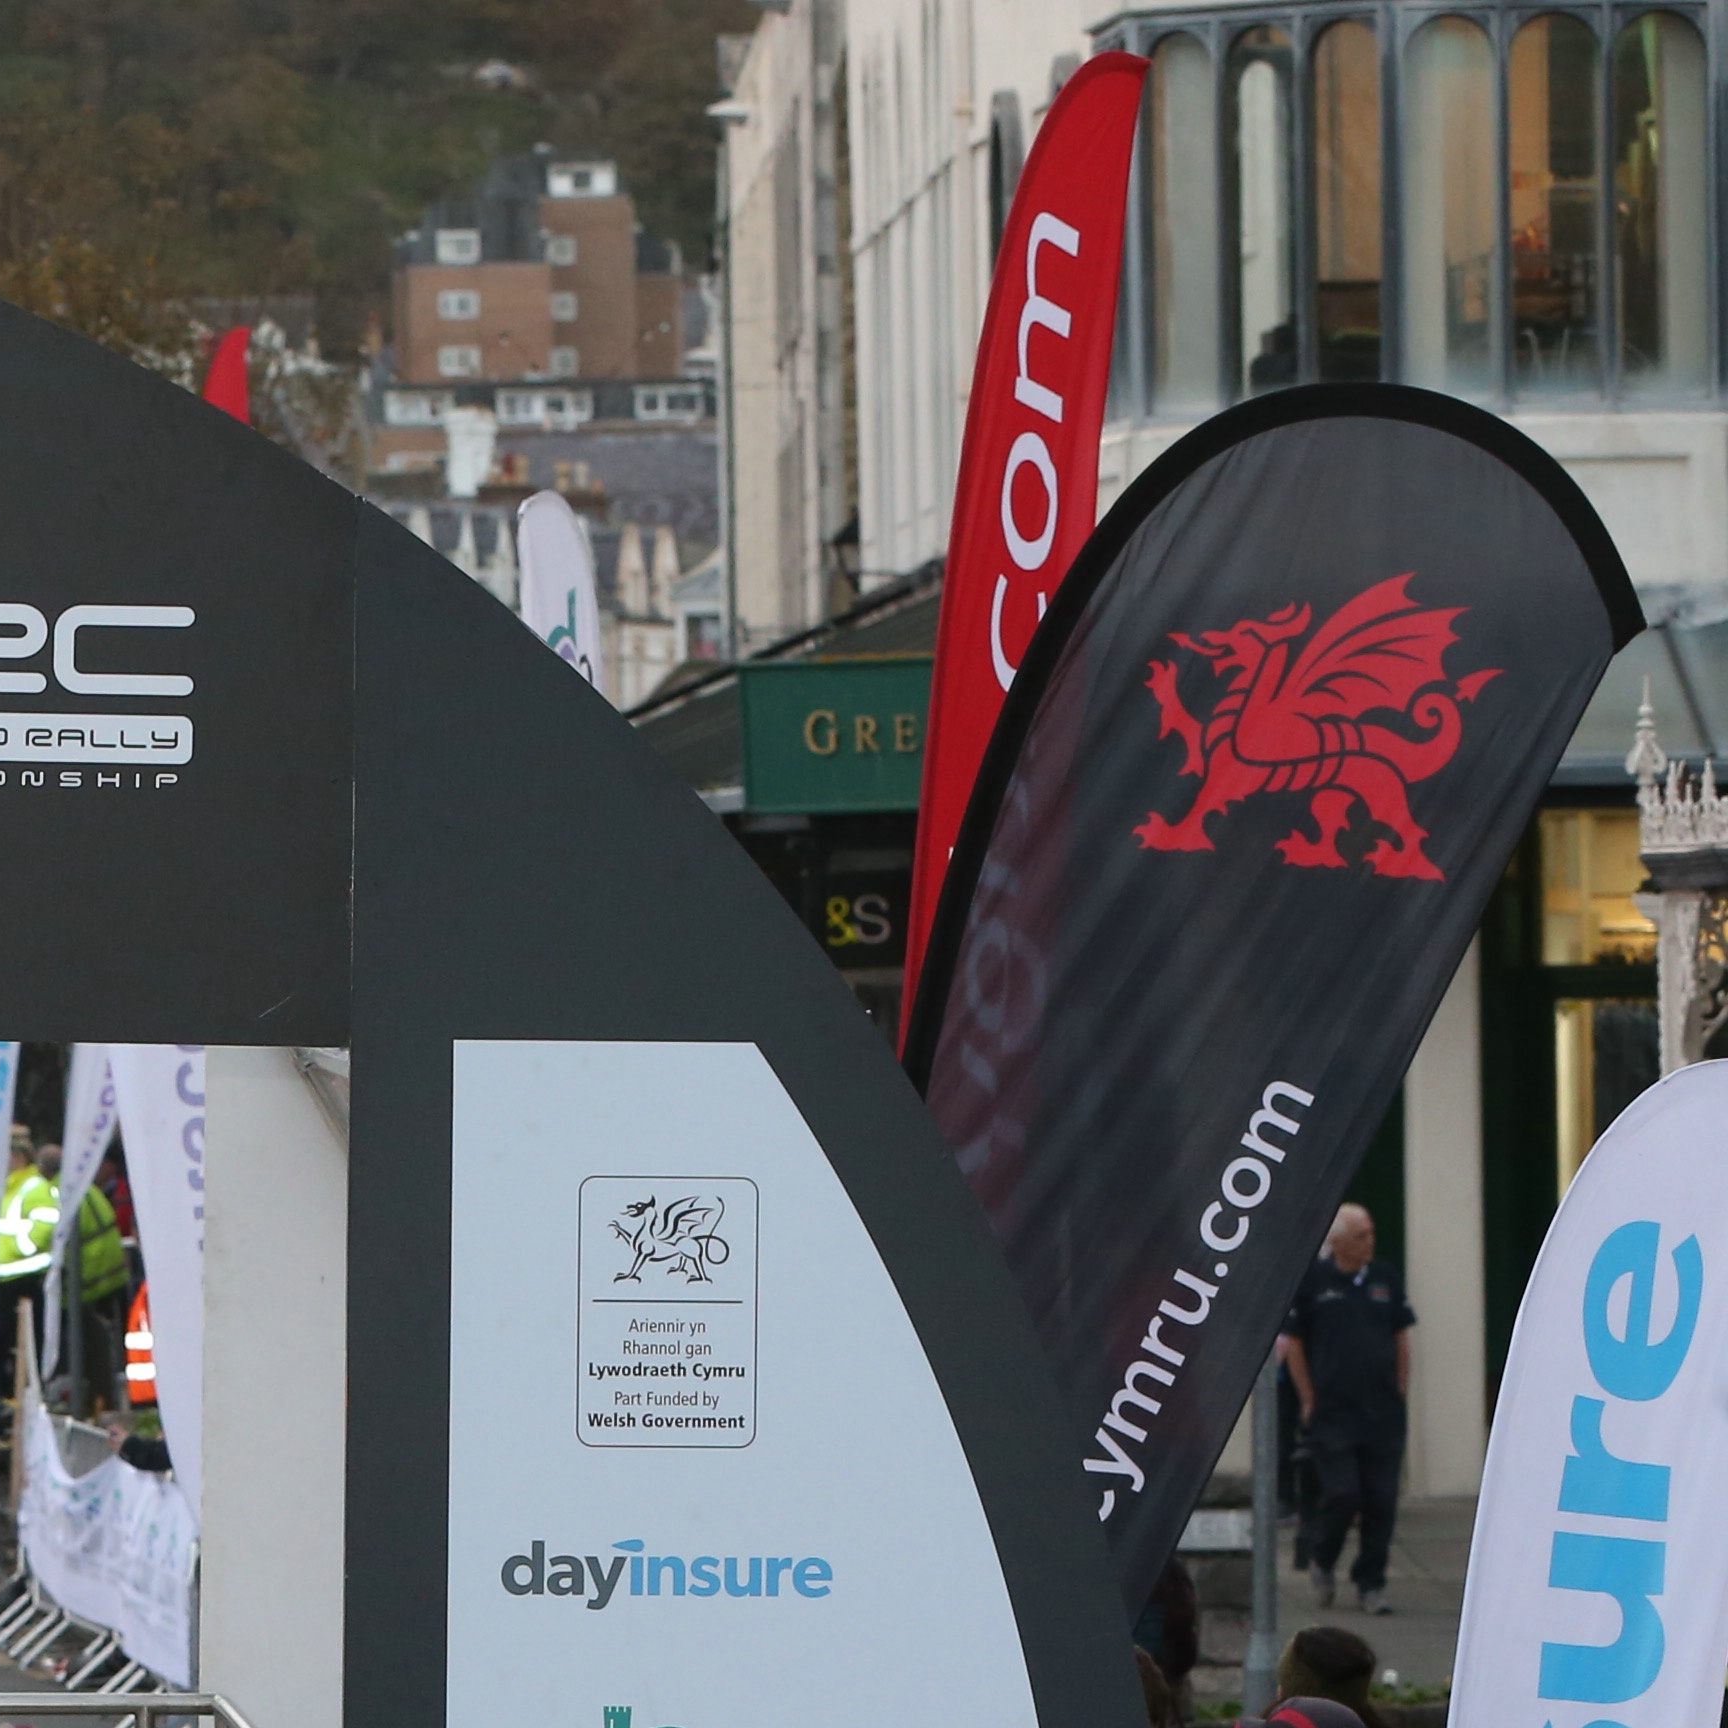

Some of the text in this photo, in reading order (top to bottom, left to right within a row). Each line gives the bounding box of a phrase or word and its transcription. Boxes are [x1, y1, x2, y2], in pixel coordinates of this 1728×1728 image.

[25, 727, 178, 749] RALLY
[804, 708, 921, 756] GRE
[628, 1318, 706, 1336] Ariennir yn
[622, 1340, 712, 1359] Rhannol gan
[589, 1362, 745, 1381] Lywodraeth Cymru
[614, 1391, 720, 1410] Part Funded by
[588, 1412, 746, 1430] Welsh Government
[501, 1538, 833, 1611] dayinsure
